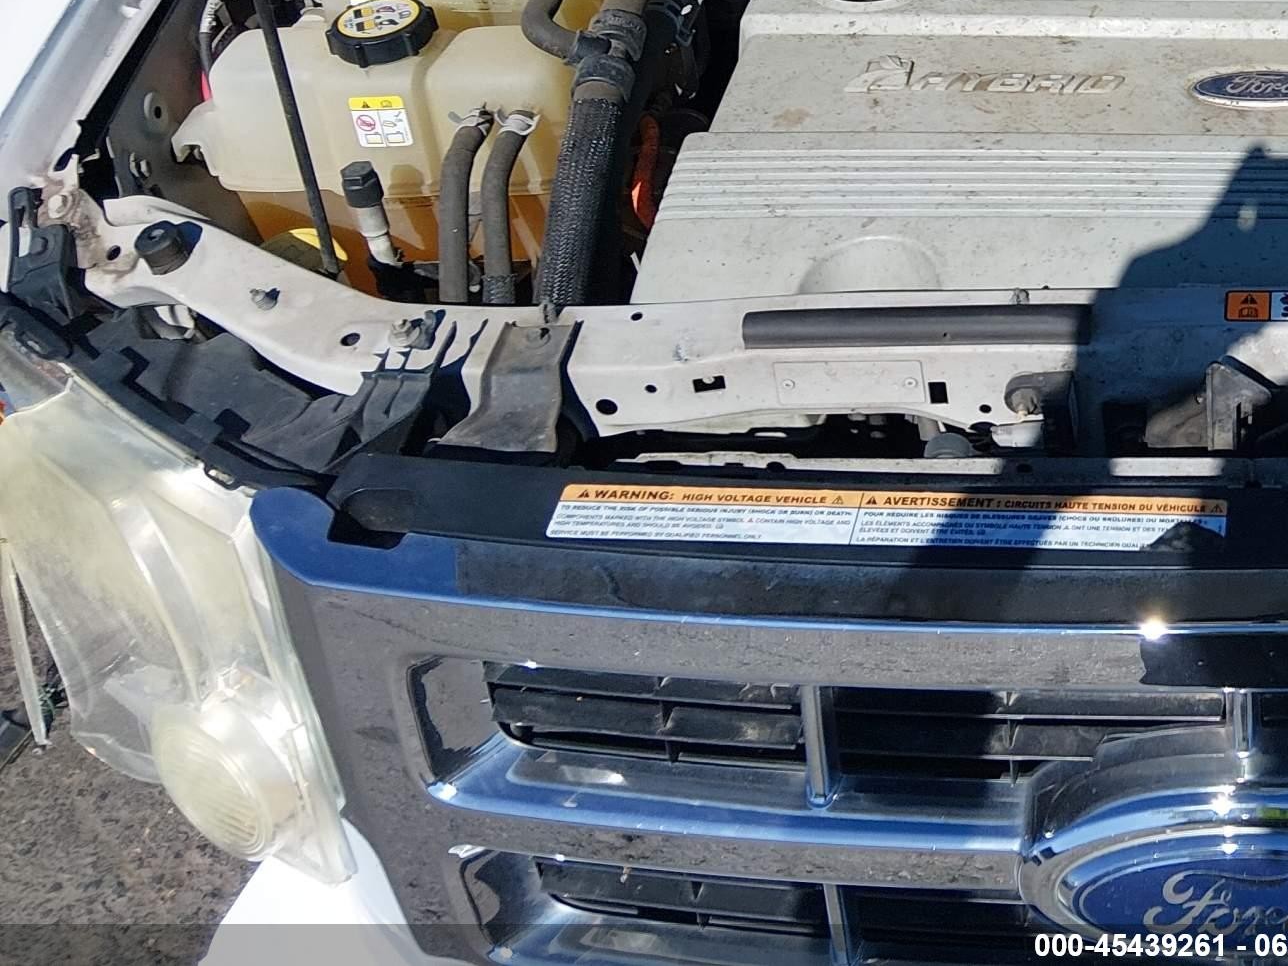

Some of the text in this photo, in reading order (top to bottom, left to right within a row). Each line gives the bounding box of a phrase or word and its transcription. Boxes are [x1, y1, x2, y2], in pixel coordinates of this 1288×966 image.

[913, 72, 1127, 94] HYBRID
[594, 489, 827, 504] WARNING: HIGH VOLTAGE VEHICLE
[884, 496, 993, 508] AVERTISSEMENT
[1005, 500, 1052, 509] CIRCUITS
[1054, 502, 1088, 510] HAUTE
[1093, 503, 1135, 511] TENSION
[1156, 502, 1206, 513] VÉHICULE
